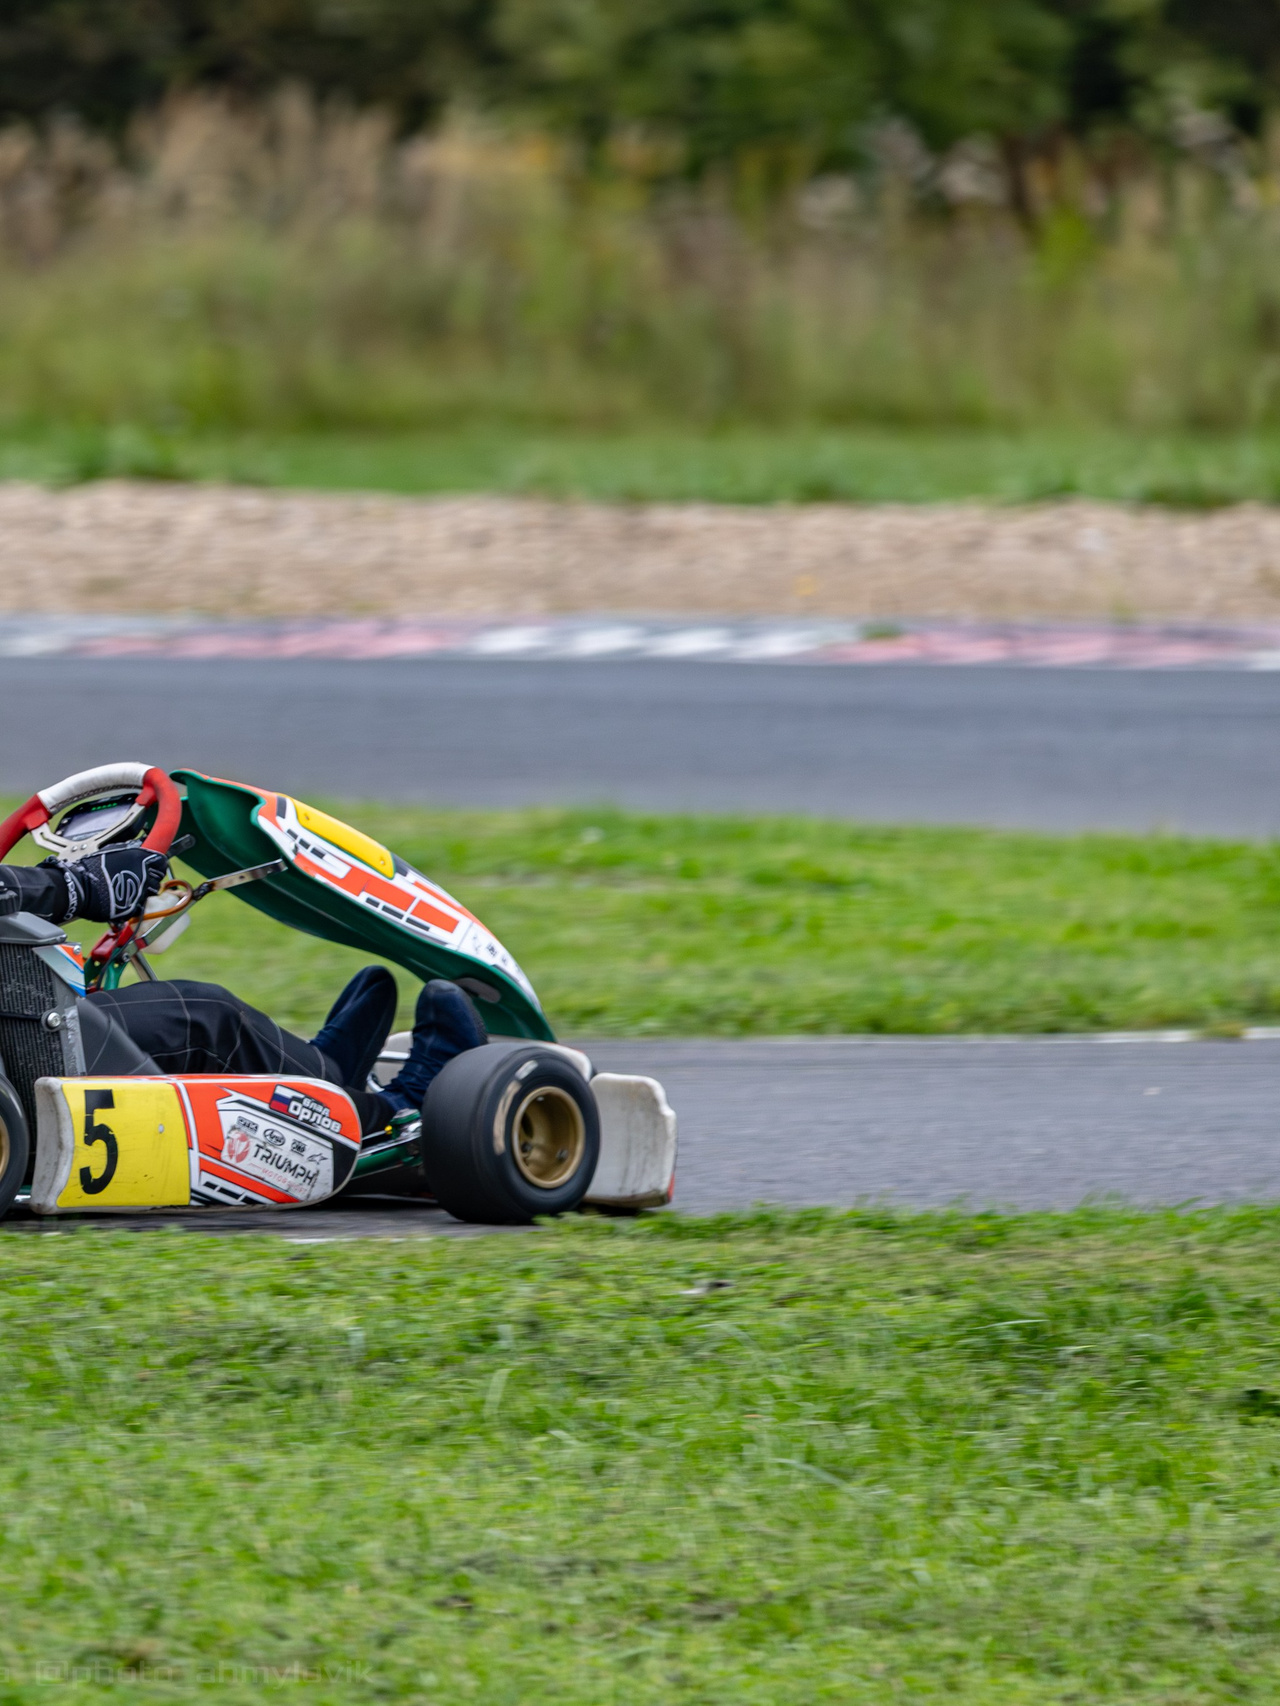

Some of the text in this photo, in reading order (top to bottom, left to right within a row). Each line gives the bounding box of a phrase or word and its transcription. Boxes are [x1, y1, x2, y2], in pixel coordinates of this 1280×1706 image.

[287, 1102, 343, 1134] Орлов
[79, 1089, 119, 1195] 5
[253, 1143, 316, 1186] TRIUMPH
